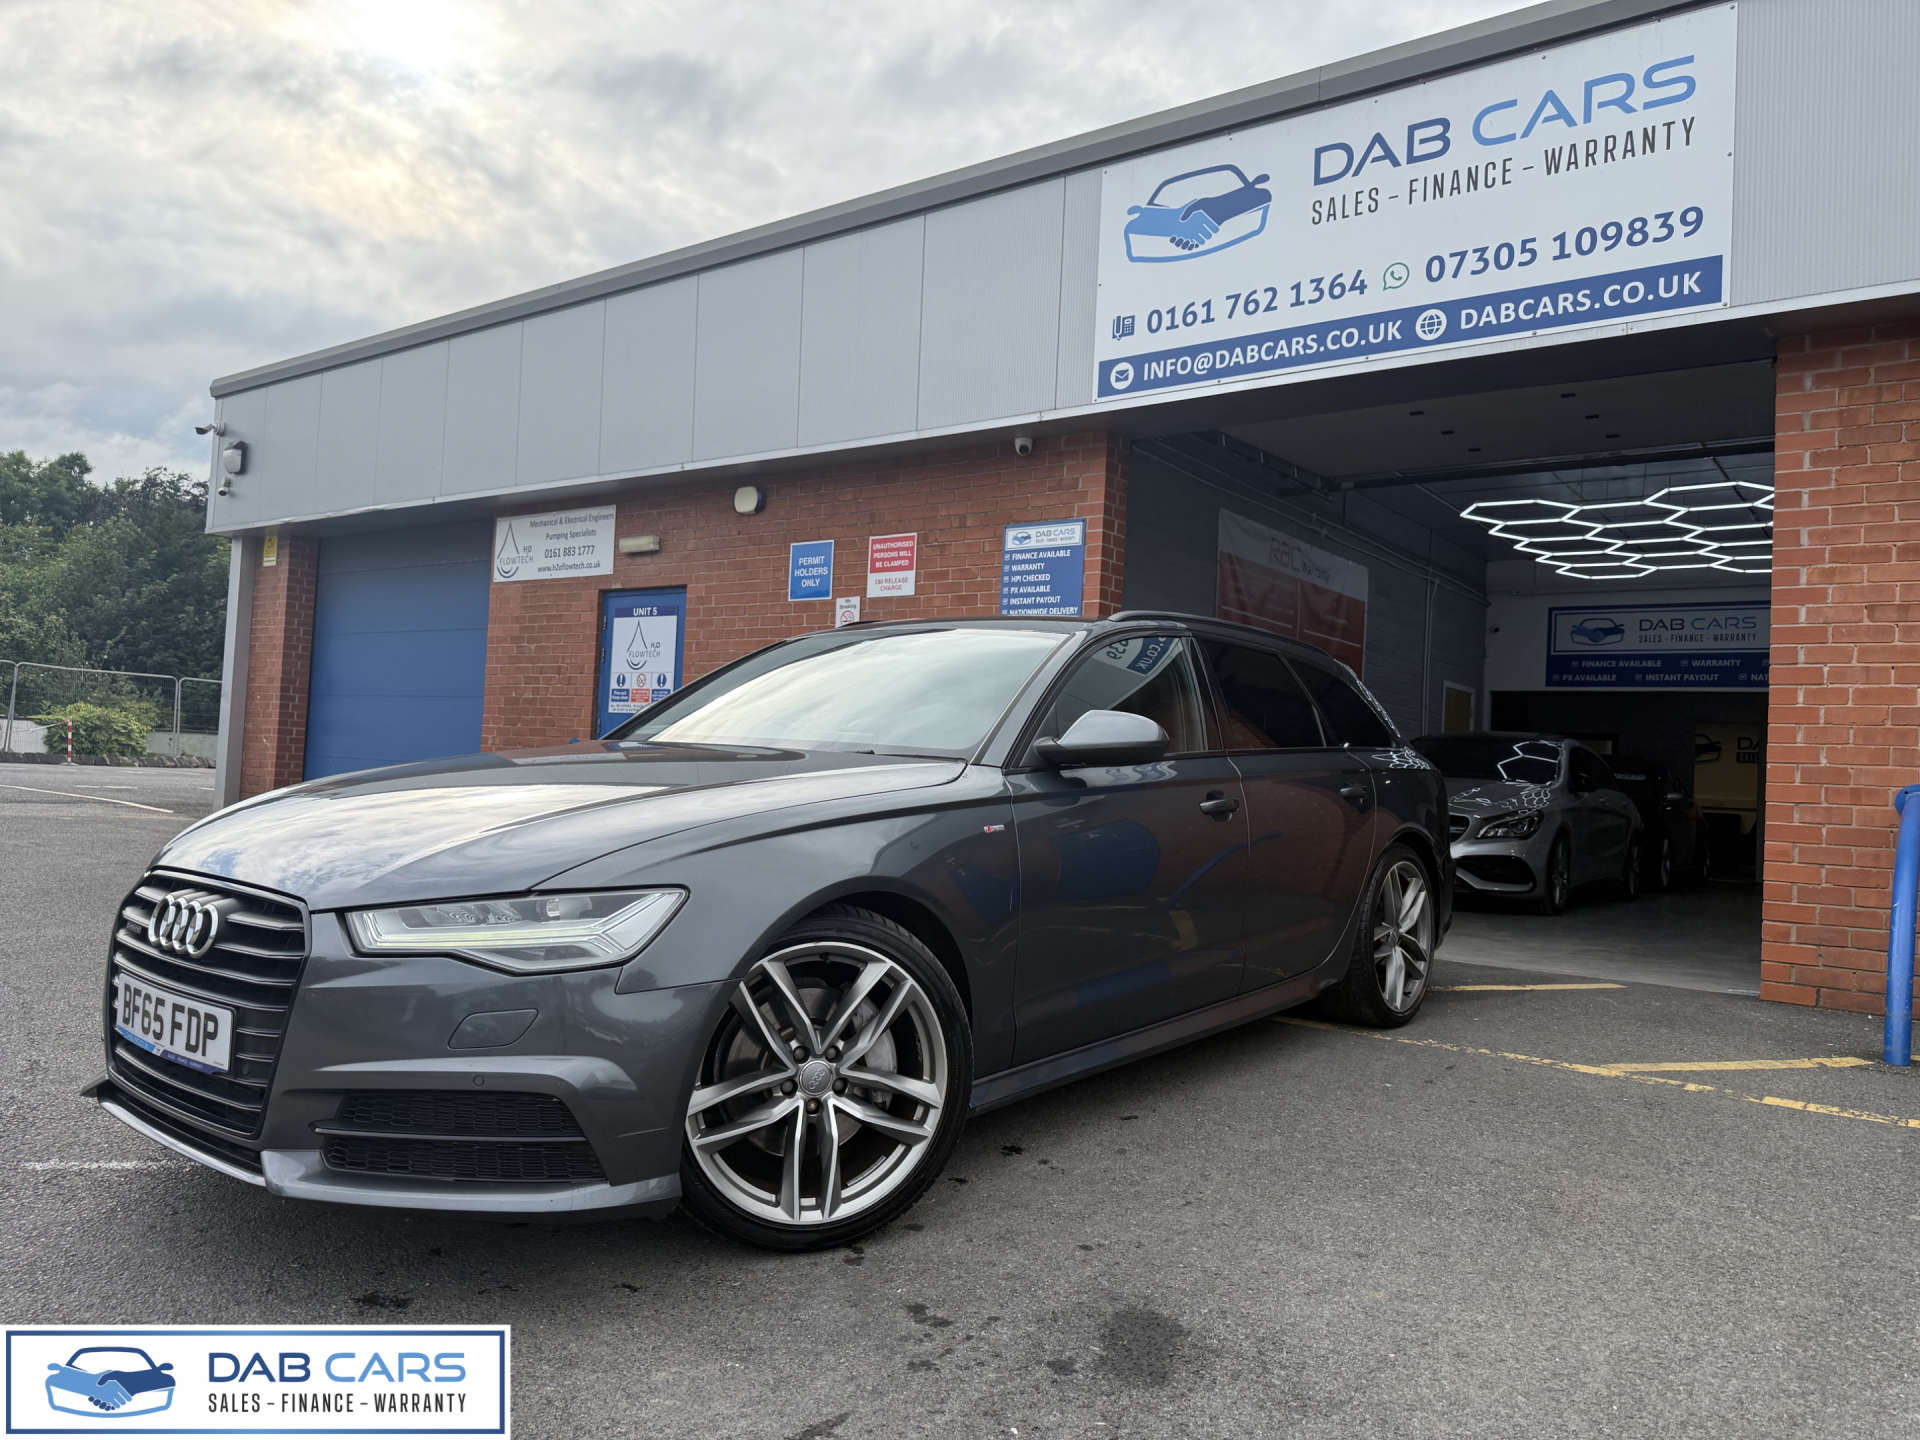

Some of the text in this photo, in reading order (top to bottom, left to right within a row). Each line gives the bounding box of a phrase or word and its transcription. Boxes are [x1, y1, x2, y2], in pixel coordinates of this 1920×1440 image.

[1313, 54, 1697, 186] DAB CARS
[1311, 117, 1697, 225] SALES FINANCE WARRANTY
[1425, 206, 1705, 283] 07305 109839
[1146, 270, 1368, 334] 0161 762 1364
[1460, 272, 1702, 330] DABCARS.CO.UK
[1142, 320, 1403, 382] INFO@DABCARS.CO.UK
[544, 548, 561, 559] 0161
[578, 545, 595, 555] 1777
[1012, 549, 1071, 560] FINANCE AVAILABLE
[798, 556, 825, 566] PERMIT
[794, 566, 829, 577] HOLDERS
[1011, 563, 1045, 571] WARRANTY
[801, 578, 821, 588] ONLY
[1022, 574, 1051, 582] CHECKED
[1019, 585, 1051, 593] AVAILABLE
[1009, 596, 1061, 605] INSTANT PAYOUT
[633, 607, 658, 616] UNIT 5
[1048, 606, 1079, 615] DELIVERY
[1639, 616, 1757, 631] DAB CARS
[1639, 633, 1757, 643] SALES FINANCE WARRANTY
[1582, 659, 1662, 668] FINANCE AVAILABLE
[1691, 659, 1741, 667] WARRANTY
[1574, 674, 1617, 682] AVAILABLE
[1683, 673, 1719, 681] PAYOUT
[122, 983, 166, 1041] BF65
[170, 1002, 219, 1057] FDP
